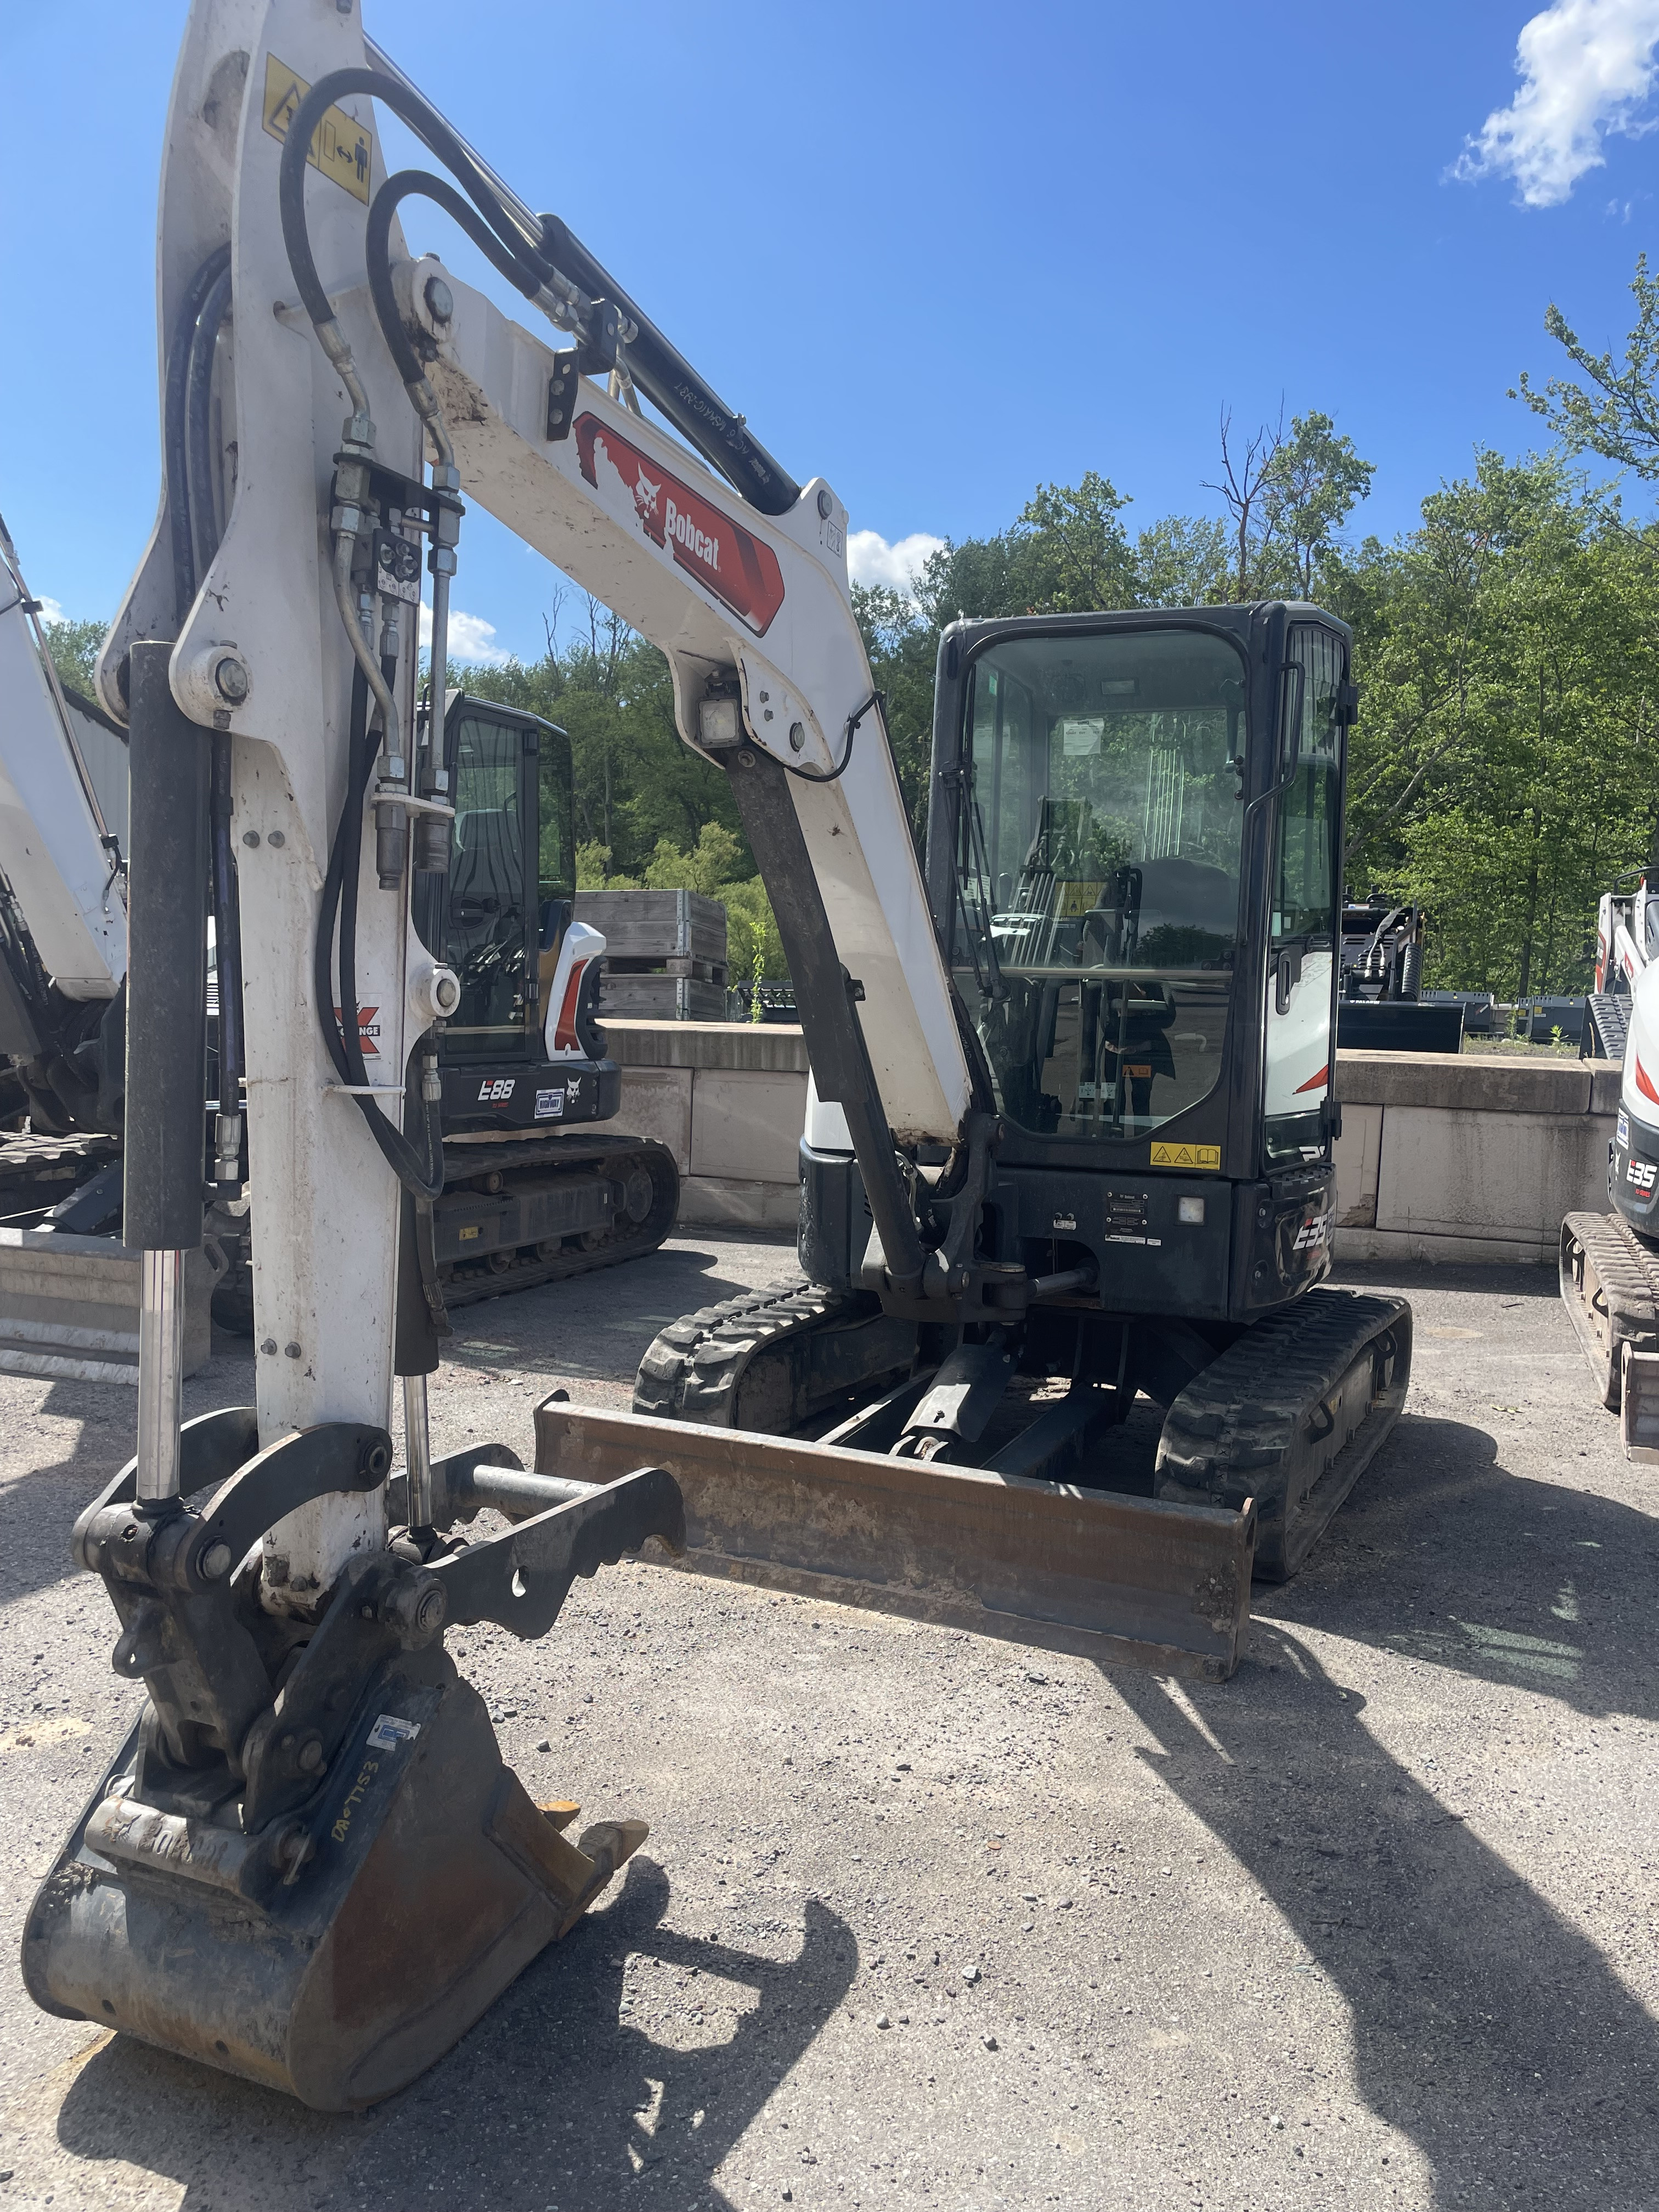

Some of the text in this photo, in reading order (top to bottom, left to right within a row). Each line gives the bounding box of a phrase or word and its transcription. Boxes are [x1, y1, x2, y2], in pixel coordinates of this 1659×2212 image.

[665, 497, 719, 571] Bobcat
[477, 1079, 516, 1101] E88
[1626, 1159, 1657, 1188] E35
